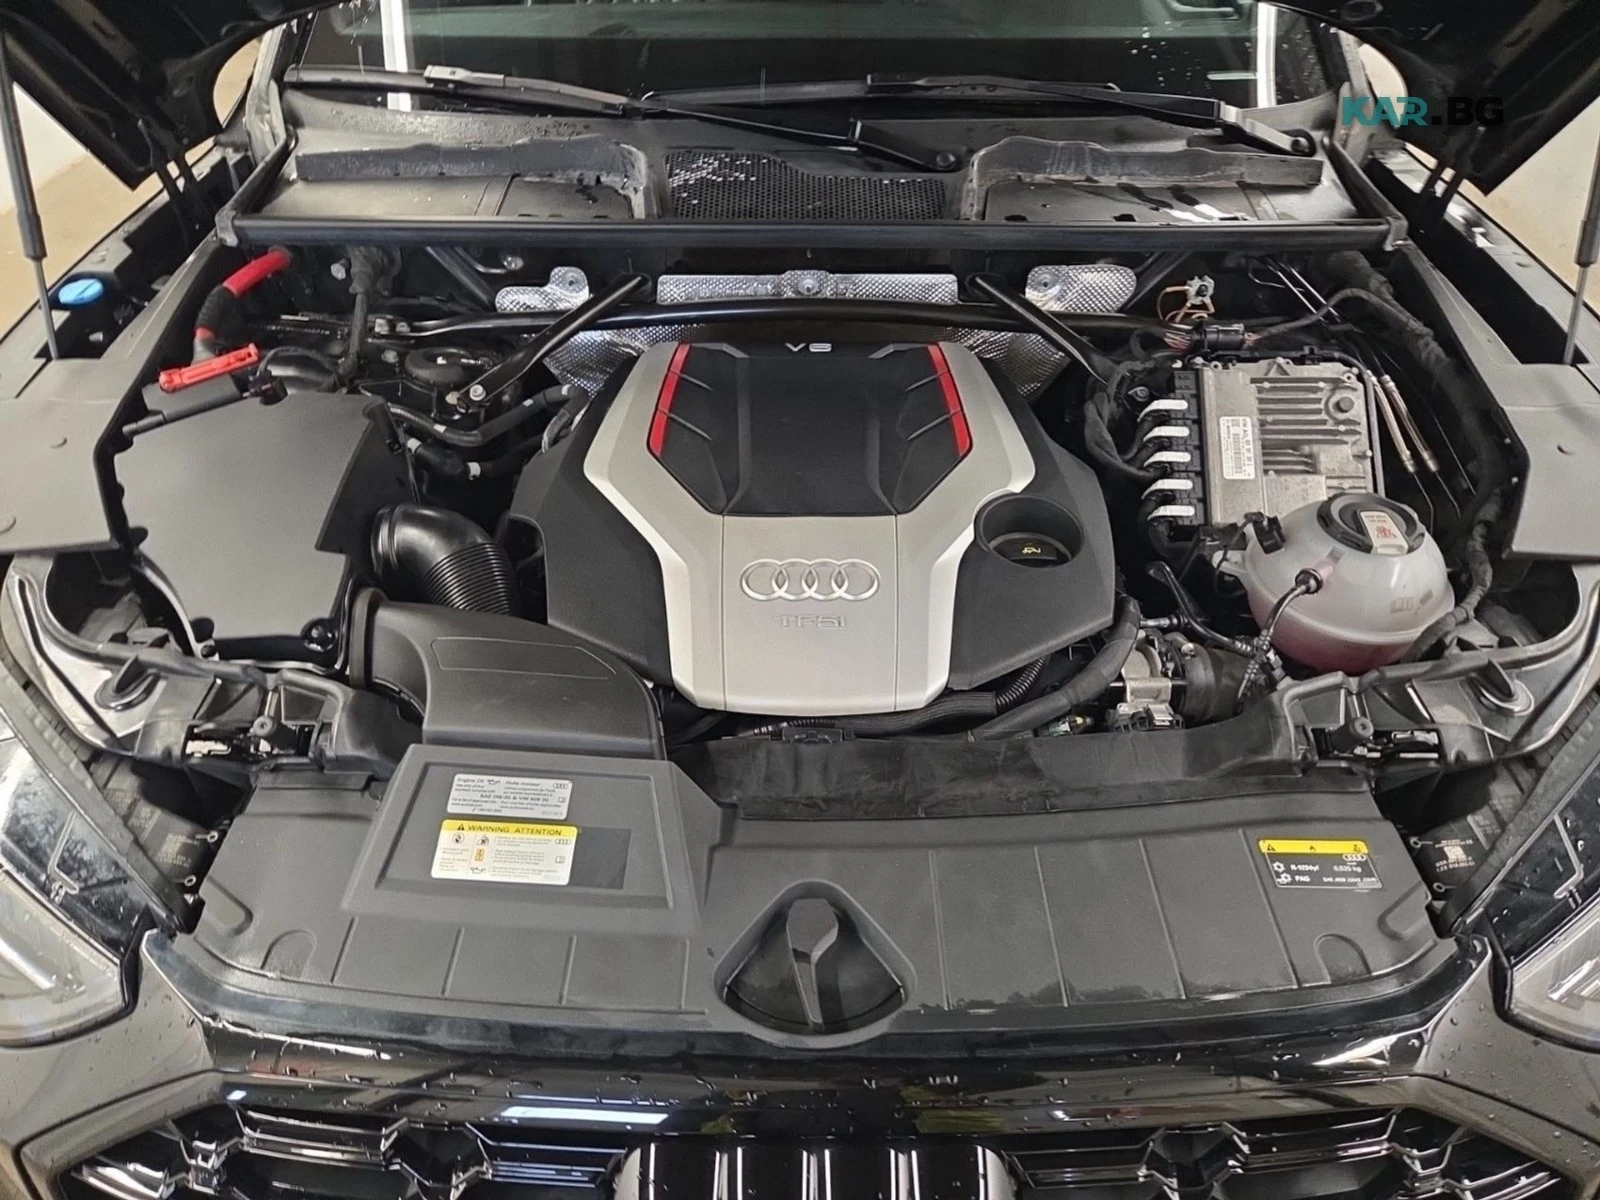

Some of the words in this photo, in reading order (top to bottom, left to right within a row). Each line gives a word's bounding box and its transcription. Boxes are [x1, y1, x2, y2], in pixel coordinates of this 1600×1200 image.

[785, 343, 832, 352] V6
[774, 614, 847, 630] TFSI
[468, 824, 510, 833] WARNING
[514, 827, 562, 836] ATTENTION
